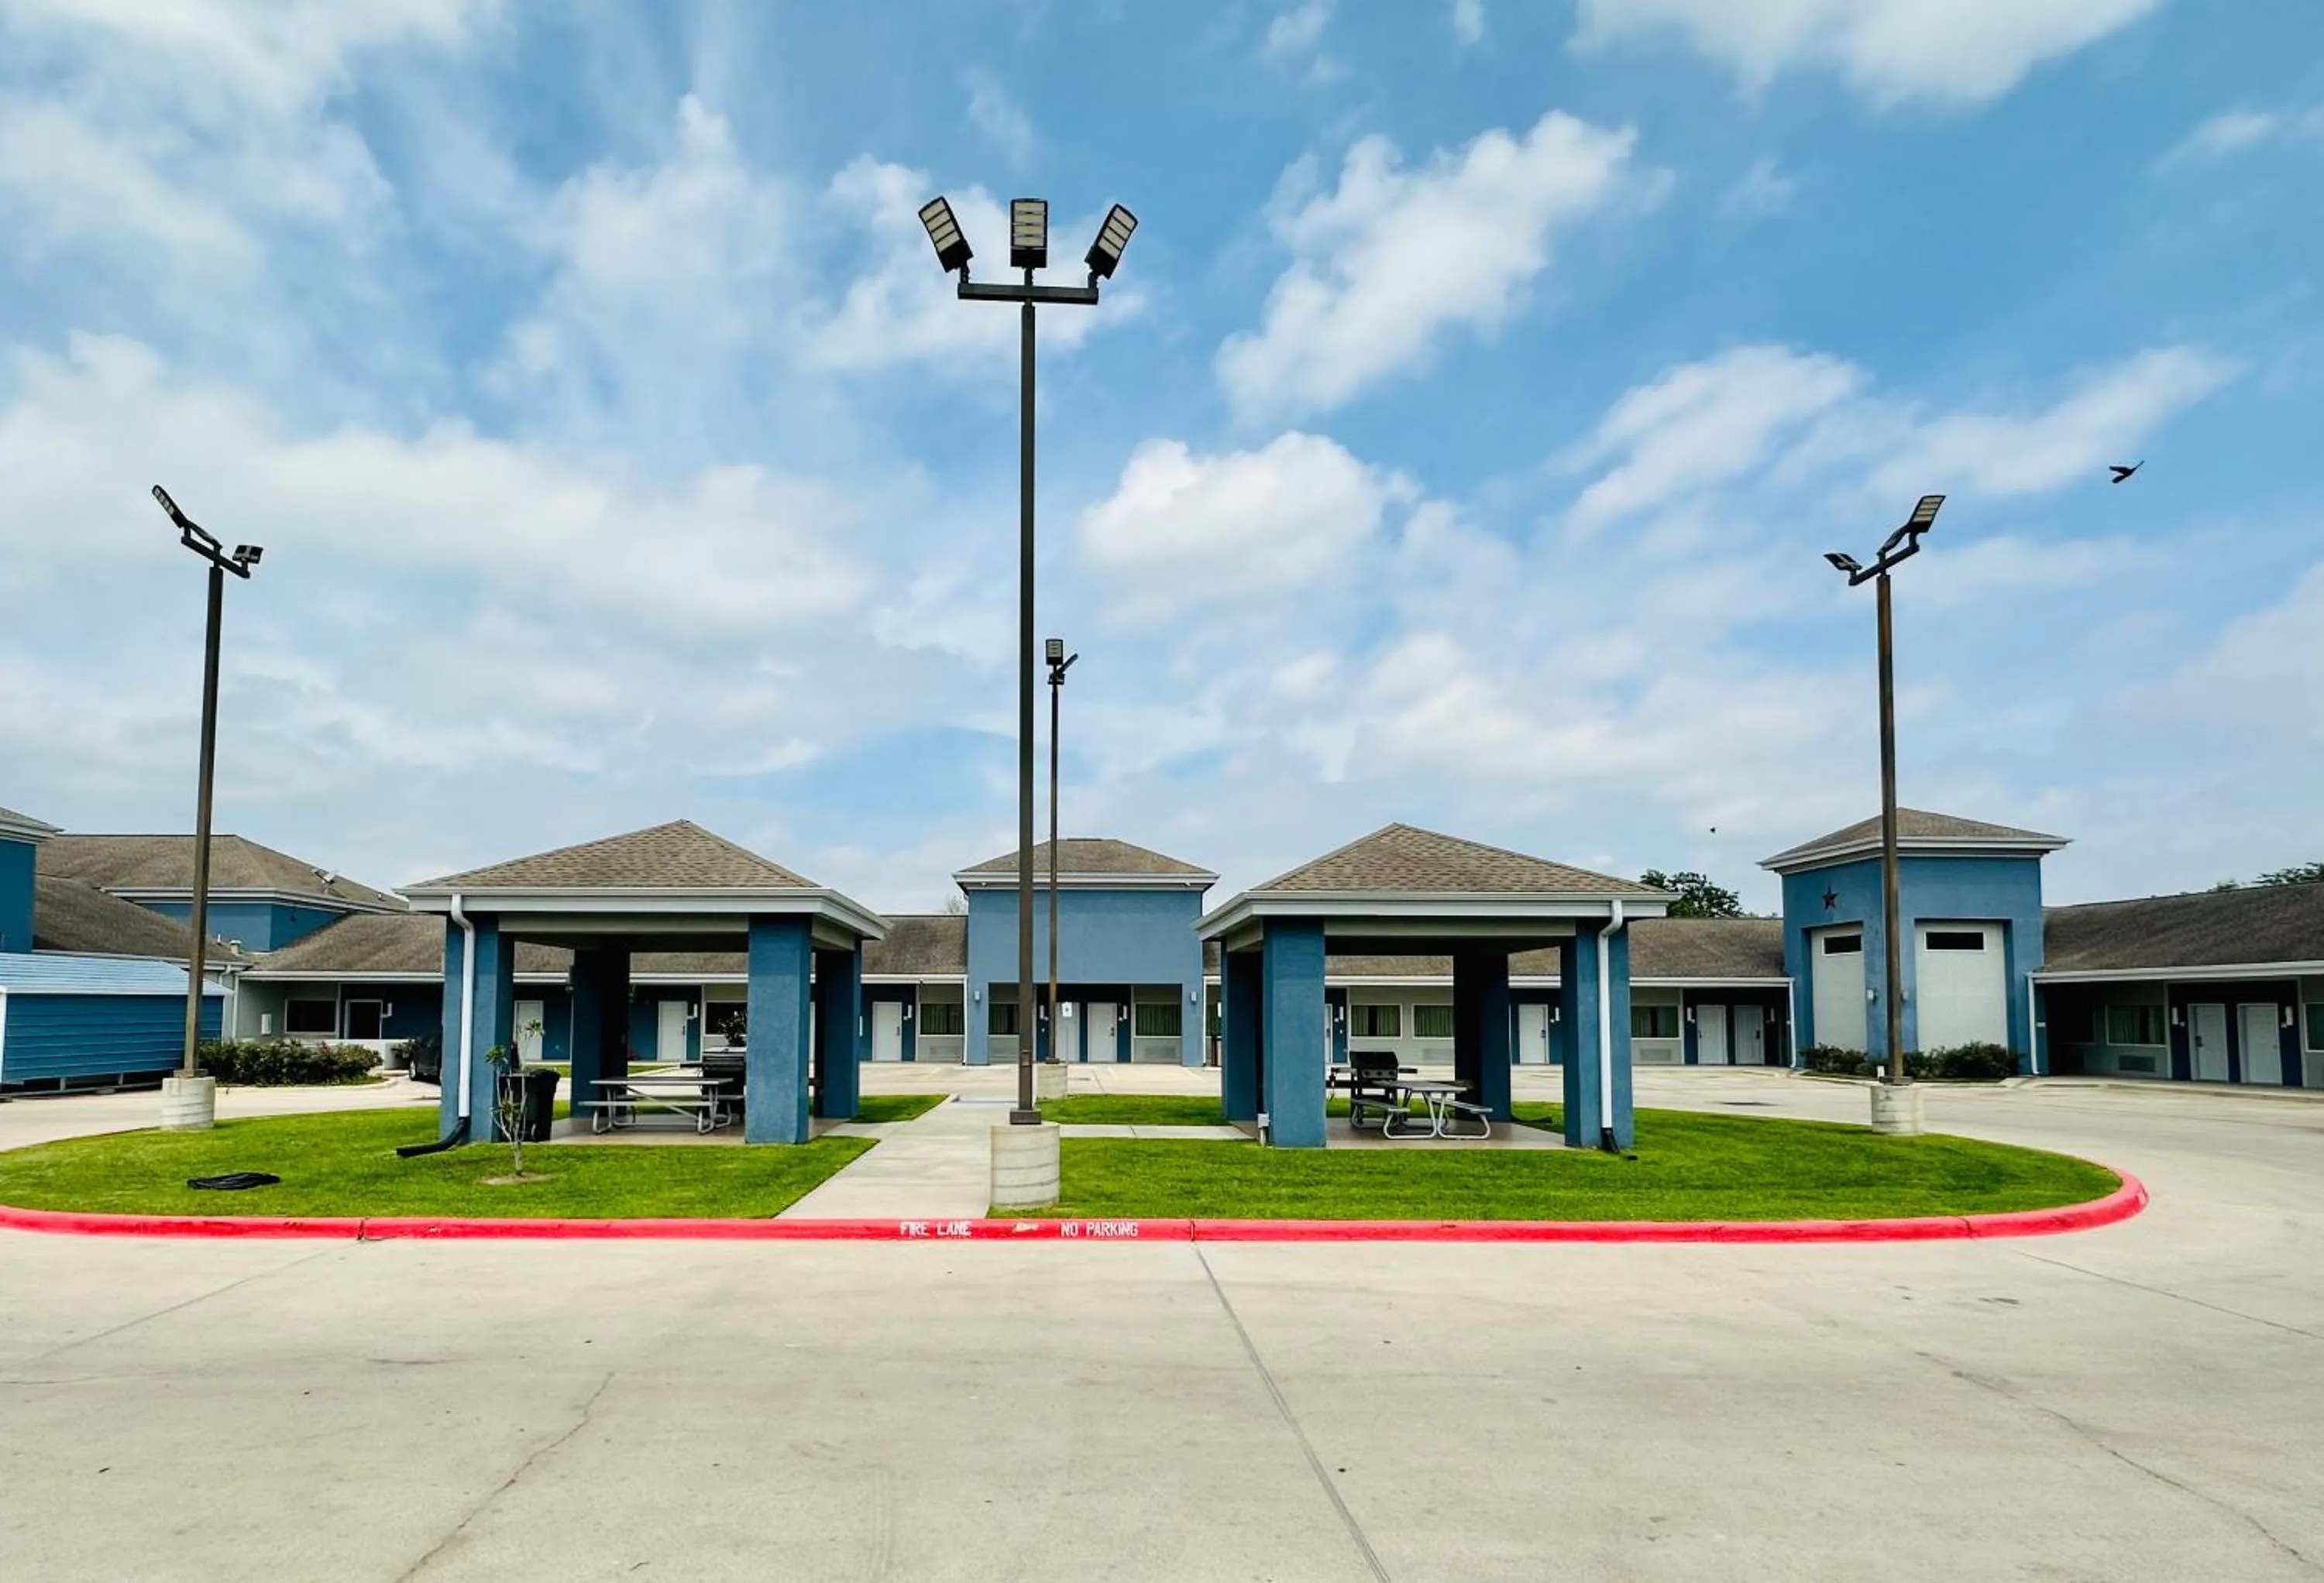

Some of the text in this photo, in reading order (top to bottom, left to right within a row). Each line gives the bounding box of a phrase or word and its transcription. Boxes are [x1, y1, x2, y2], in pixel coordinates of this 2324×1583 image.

[900, 1221, 1138, 1237] FIRE LANE NO PARKING
